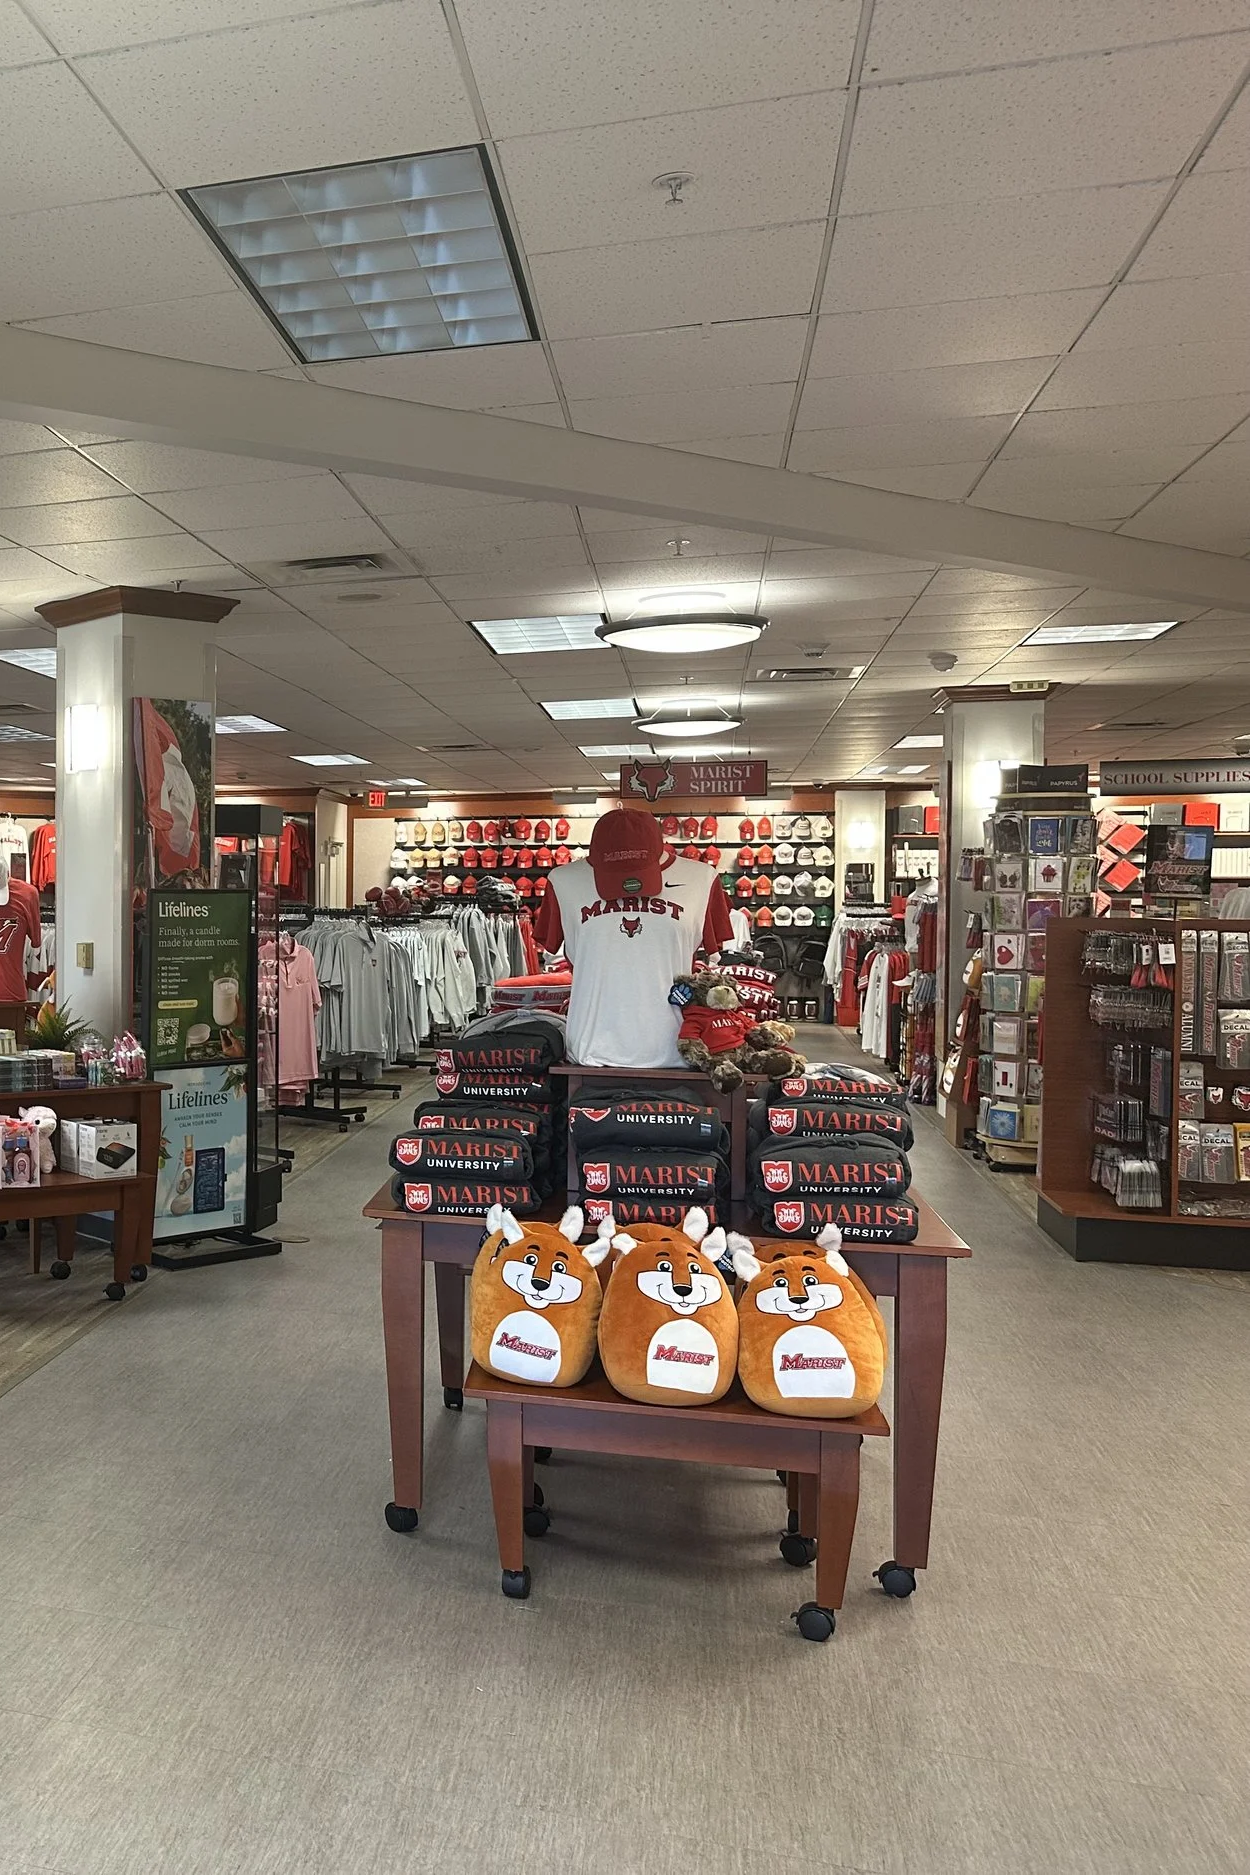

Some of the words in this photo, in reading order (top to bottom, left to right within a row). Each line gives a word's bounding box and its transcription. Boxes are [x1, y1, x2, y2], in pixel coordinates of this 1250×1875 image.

[690, 765, 754, 779] MARIST
[1104, 772, 1170, 785] SCHOOL
[1173, 770, 1250, 784] SUPPLIES
[690, 780, 746, 793] SPIRIT
[369, 792, 386, 807] EXIT
[603, 850, 648, 862] MARIST
[1148, 861, 1209, 875] MARIST
[158, 901, 209, 918] Lifelines
[581, 896, 684, 924] MARIST
[158, 927, 189, 937] Finally,
[195, 926, 220, 935] candle
[158, 939, 181, 947] made
[182, 938, 193, 947] for
[194, 938, 215, 947] dorm
[217, 938, 240, 946] rooms.
[711, 965, 777, 984] MARIST
[1181, 1013, 1193, 1051] ALUMNI
[458, 1047, 541, 1066] MARIST
[463, 1086, 528, 1096] UNIVERSITY
[812, 1079, 905, 1094] MARIST
[169, 1091, 228, 1110] Lifelines
[449, 1116, 537, 1135] MARIST
[617, 1114, 695, 1125] UNIVERSITY
[802, 1109, 904, 1132] MARIST
[426, 1139, 522, 1159] MARIST
[427, 1158, 500, 1170] UNIVERSITY
[798, 1161, 904, 1183] MARIST
[616, 1165, 716, 1185] MARIST
[437, 1184, 530, 1204] MARIST
[618, 1187, 695, 1196] UNIVERSITY
[800, 1186, 882, 1194] UNIVERSITY
[618, 1202, 717, 1224] MARIT
[809, 1202, 915, 1227] MARIST
[496, 1331, 558, 1361] MARIST
[653, 1344, 715, 1367] MARIST
[780, 1353, 846, 1372] MARIST
